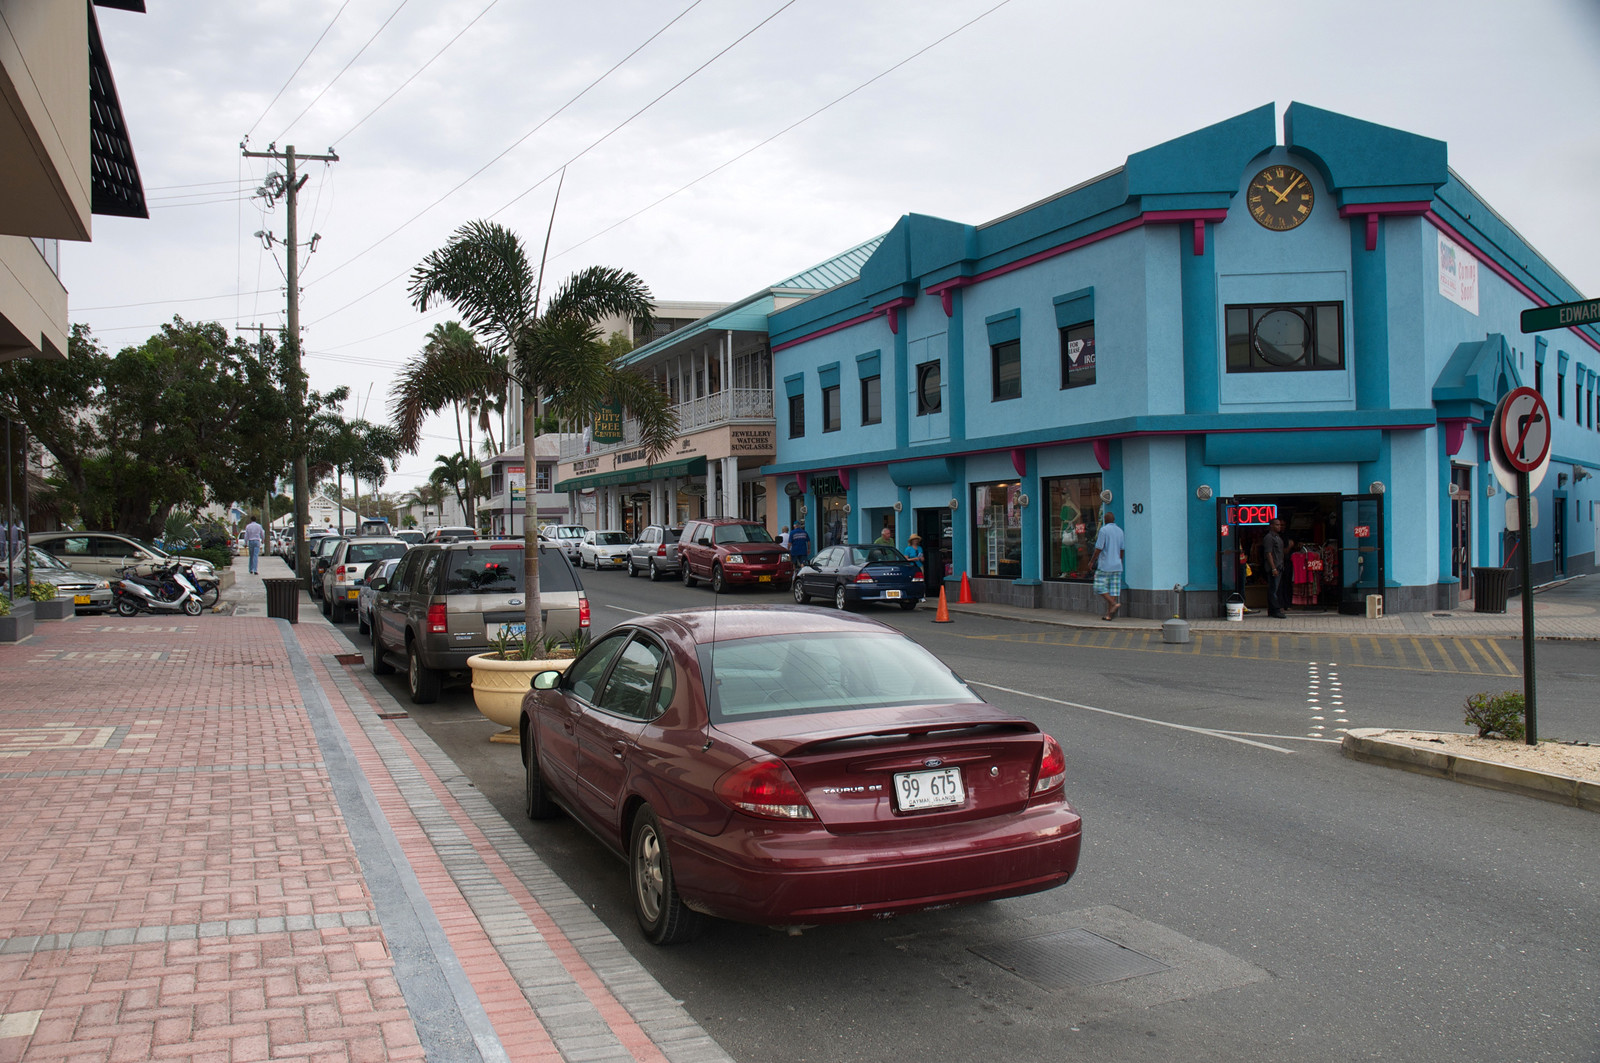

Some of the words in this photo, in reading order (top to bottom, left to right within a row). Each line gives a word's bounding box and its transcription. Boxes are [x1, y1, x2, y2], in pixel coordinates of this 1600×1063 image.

[1560, 303, 1600, 323] EDWAR
[594, 422, 620, 431] FREE
[1132, 503, 1143, 514] 30
[1238, 506, 1276, 524] OPEN
[823, 786, 865, 795] TAURUS
[902, 778, 920, 799] 99
[931, 774, 956, 796] 675
[909, 797, 930, 805] CAYMAN
